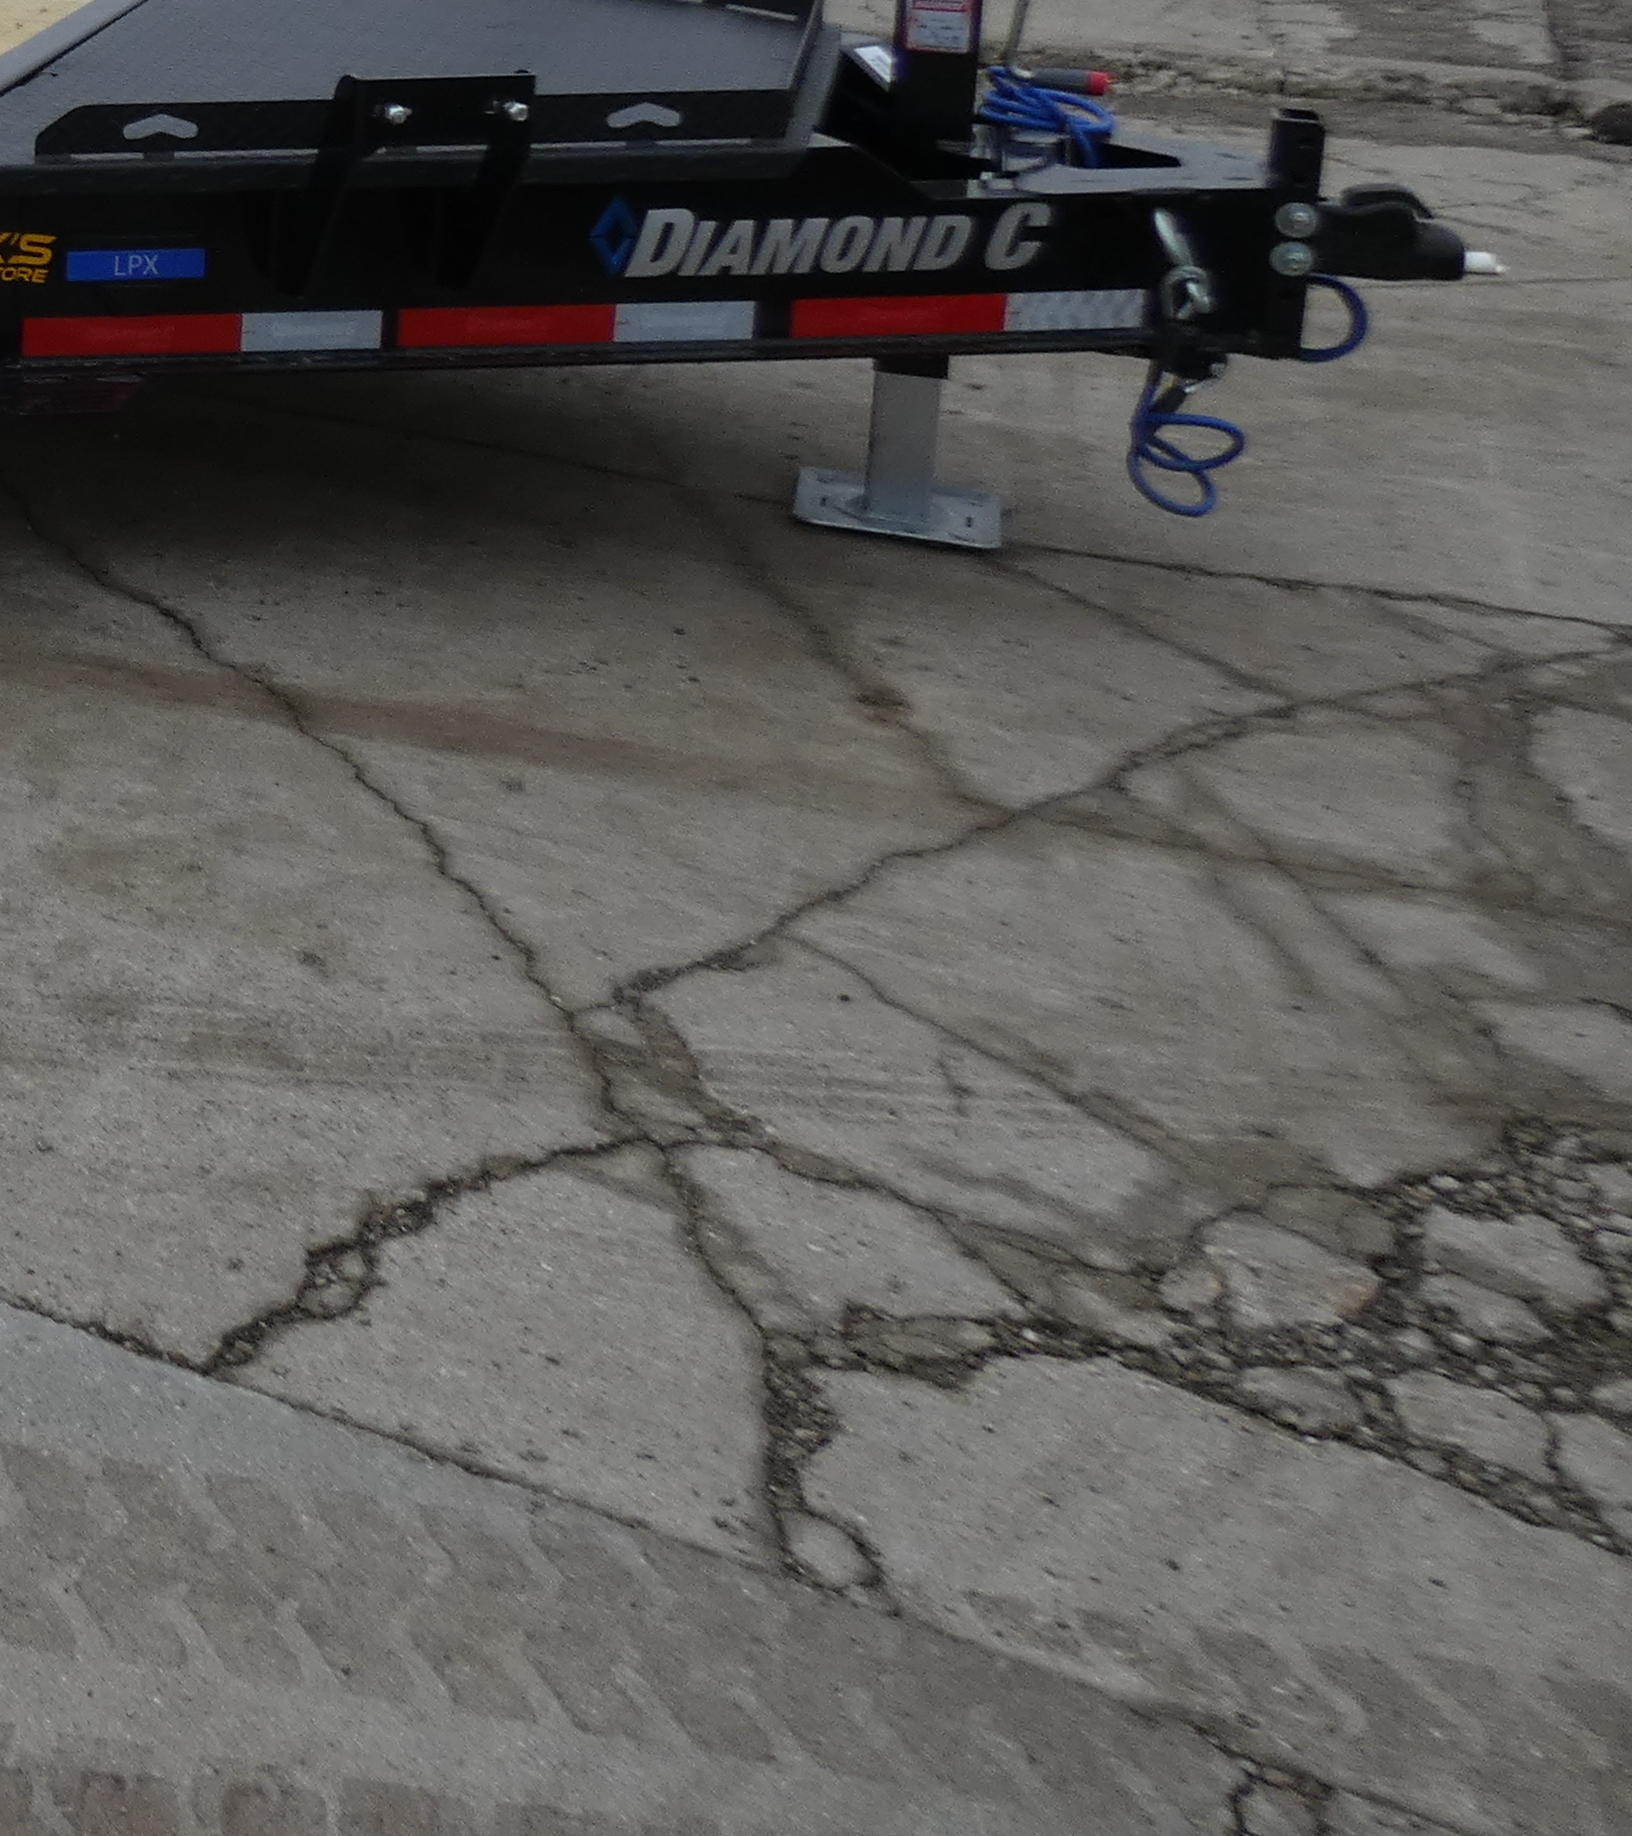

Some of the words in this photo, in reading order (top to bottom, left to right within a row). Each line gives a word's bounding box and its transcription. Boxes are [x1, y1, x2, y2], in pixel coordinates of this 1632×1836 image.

[624, 208, 974, 278] DIAMOND
[984, 201, 1053, 271] C
[113, 254, 160, 277] LPX
